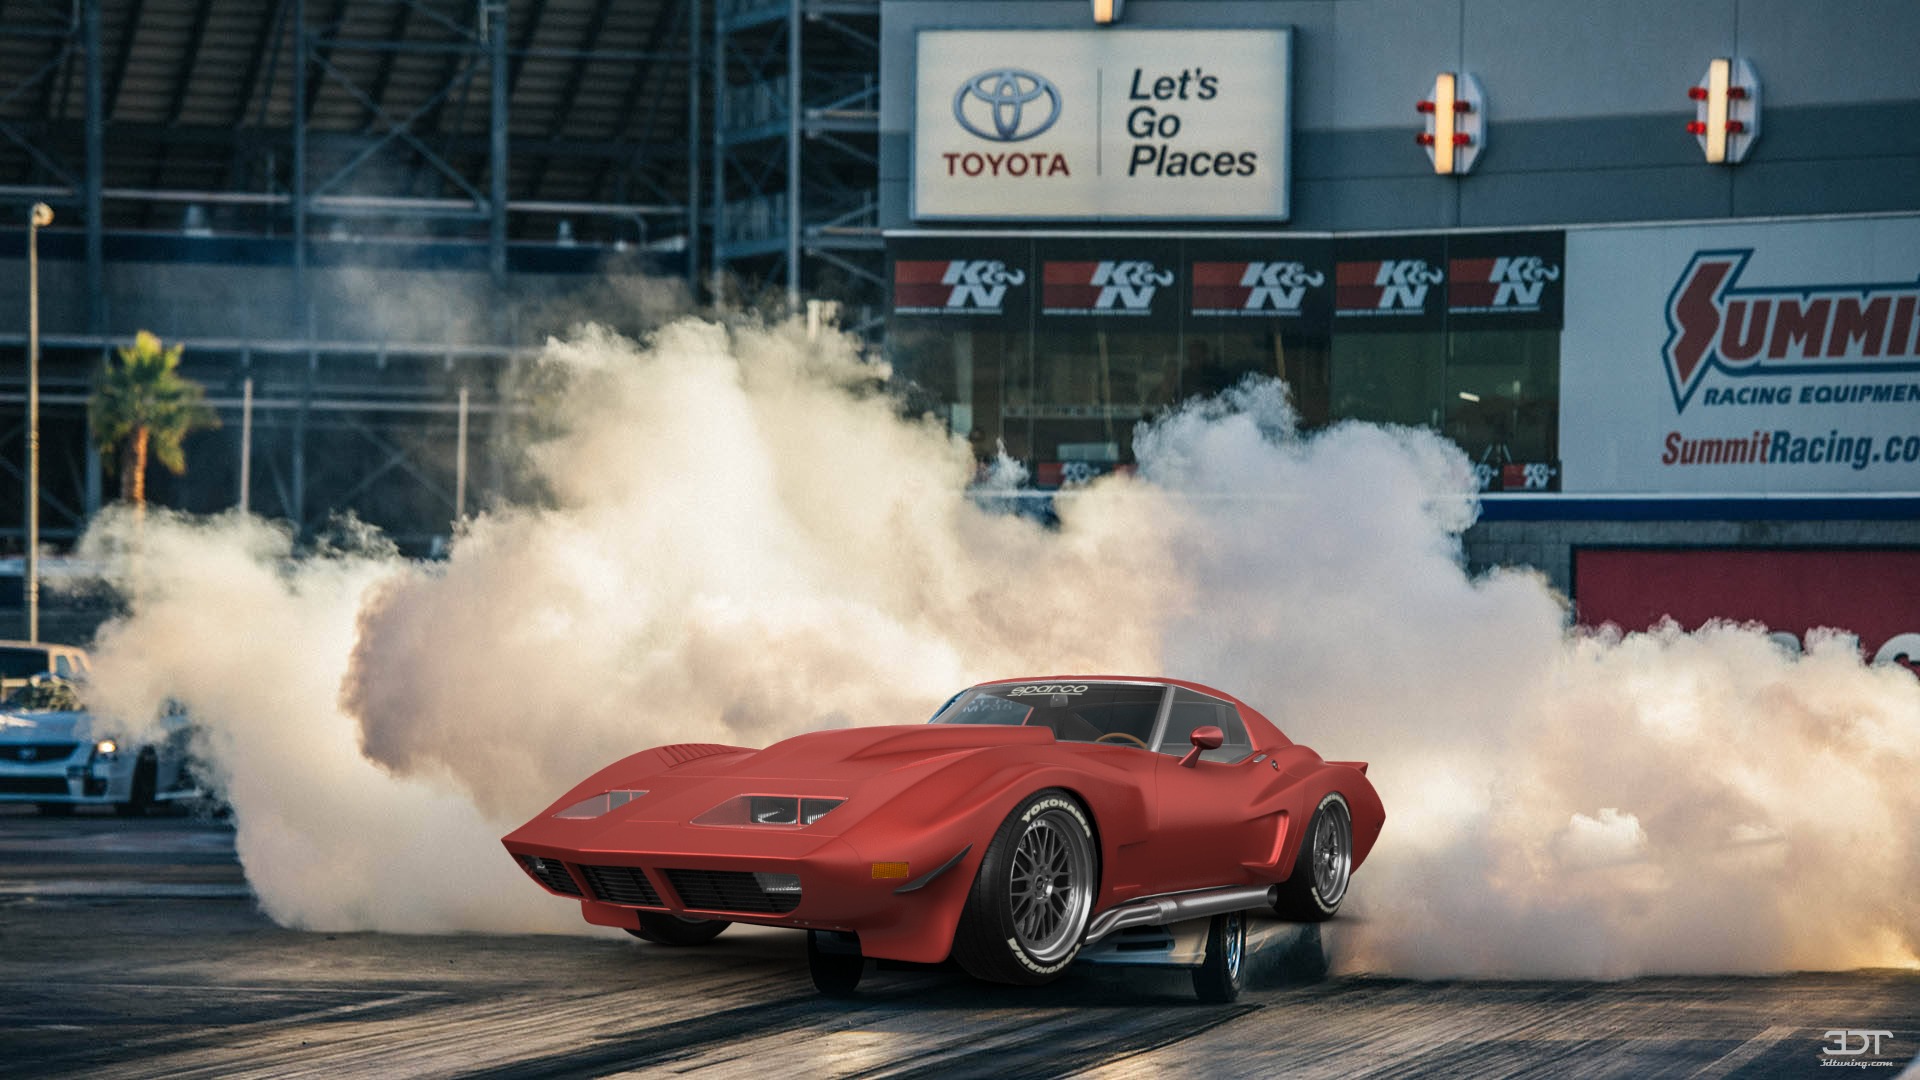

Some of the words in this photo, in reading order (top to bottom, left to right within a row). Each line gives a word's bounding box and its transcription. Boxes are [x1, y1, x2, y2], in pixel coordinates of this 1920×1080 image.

[1129, 68, 1219, 101] Let's
[1127, 106, 1181, 139] Go
[943, 152, 1070, 177] TOYOTA
[1128, 144, 1258, 178] Places
[941, 260, 1026, 307] K&N
[1090, 261, 1174, 309] K&N
[1240, 261, 1325, 310] K&N
[1374, 260, 1444, 309] K&N
[1488, 256, 1560, 307] K&N
[1703, 387, 1792, 406] RACING
[1006, 684, 1089, 697] sparco
[1021, 799, 1091, 839] YOKOHAMA
